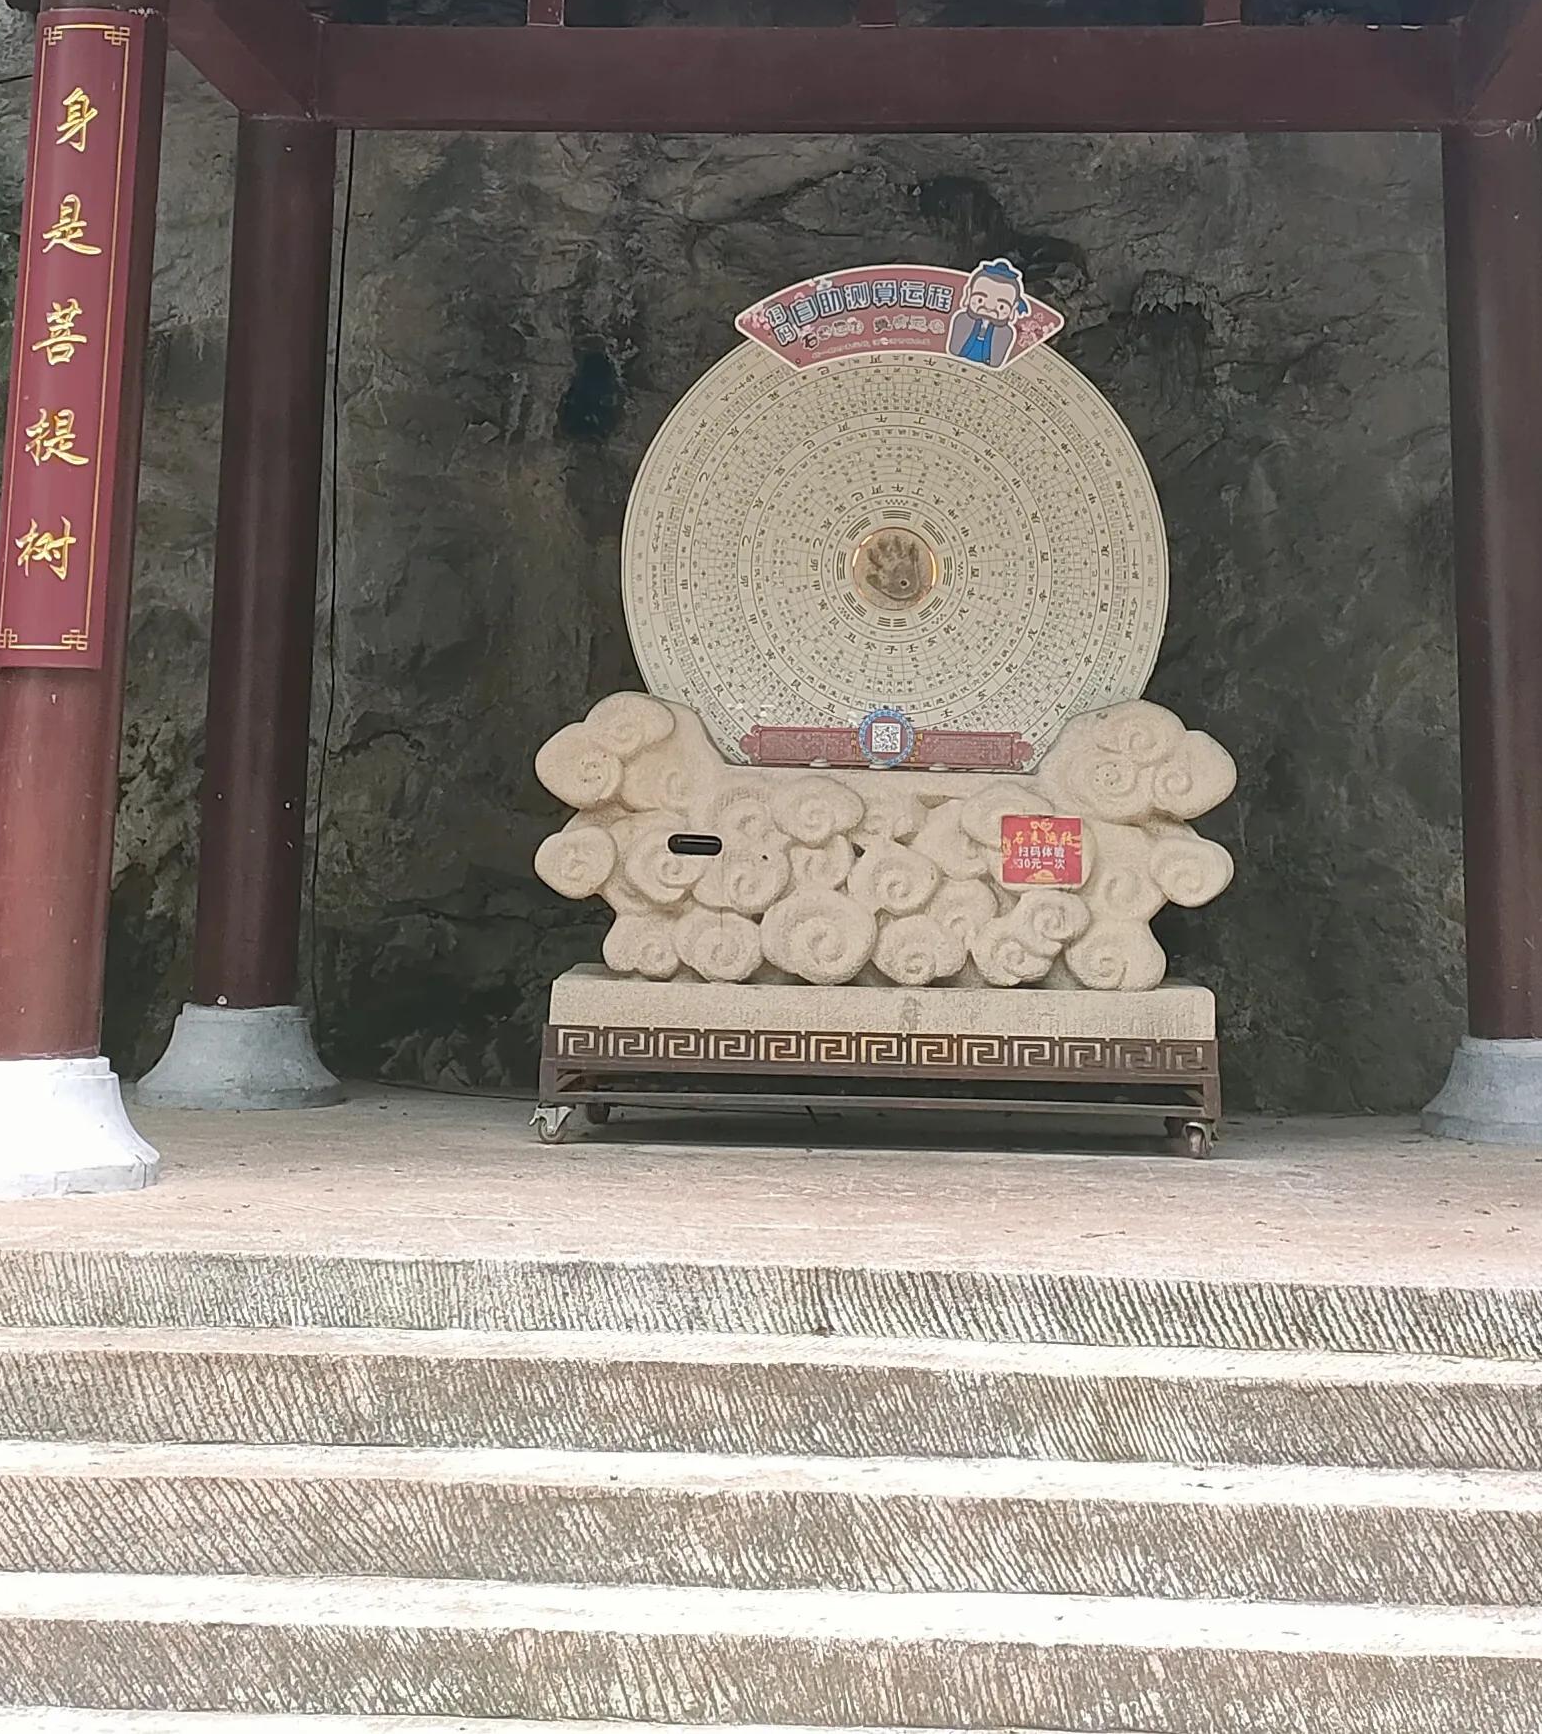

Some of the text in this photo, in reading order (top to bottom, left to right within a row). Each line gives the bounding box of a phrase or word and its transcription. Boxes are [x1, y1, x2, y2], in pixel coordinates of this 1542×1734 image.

[14, 86, 103, 581] 身是菩提树
[1018, 845, 1065, 858] 扫码体验
